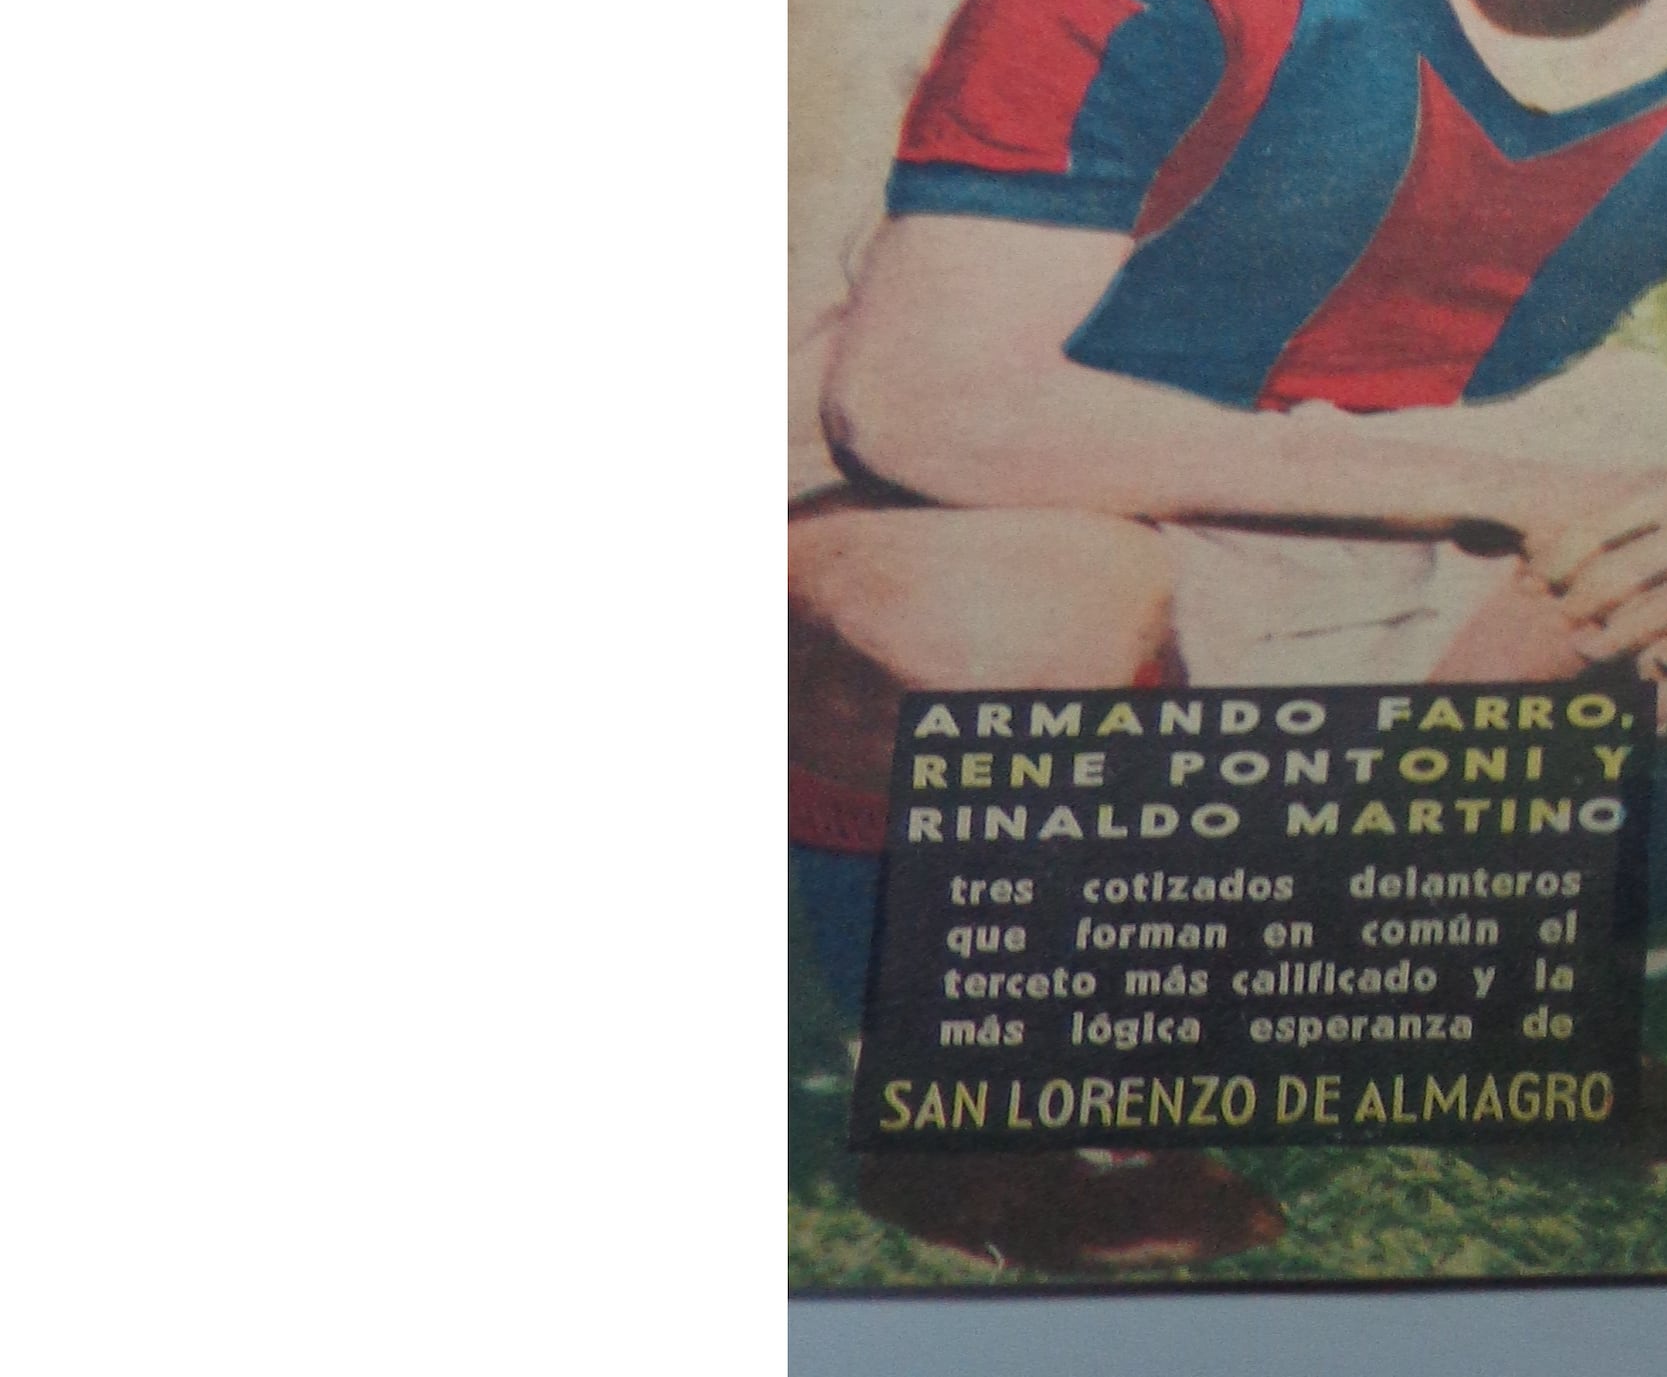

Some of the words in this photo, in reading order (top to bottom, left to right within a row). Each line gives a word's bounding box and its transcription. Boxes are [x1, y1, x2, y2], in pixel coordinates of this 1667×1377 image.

[914, 700, 1326, 737] ARMANDO
[1377, 693, 1633, 731] FARRO,
[913, 752, 1105, 789] RENE
[1170, 746, 1542, 786] PONTONI
[1594, 745, 1632, 780] Y
[908, 803, 1240, 842] RINALDO
[1286, 797, 1625, 836] MARTINO
[950, 876, 1033, 905] tres
[1083, 868, 1294, 903] cotizados
[1350, 865, 1581, 900] delanteros
[947, 925, 1026, 958] que
[1076, 917, 1227, 950] forman
[1263, 922, 1313, 948] en
[1361, 913, 1499, 946] común
[1538, 910, 1577, 944] el
[944, 967, 1096, 999] terceto
[1125, 964, 1208, 996] más
[1232, 959, 1437, 996] calificado
[1473, 967, 1495, 998] y
[1535, 957, 1574, 991] la
[940, 1014, 1024, 1046] más
[1072, 1011, 1200, 1050] lógica
[1250, 1014, 1473, 1047] esperanza
[1522, 1005, 1573, 1039] de
[880, 1080, 988, 1130] SAN
[1008, 1075, 1256, 1128] LORENZO
[1277, 1075, 1341, 1124] DE
[1355, 1071, 1613, 1123] ALMAGRO
